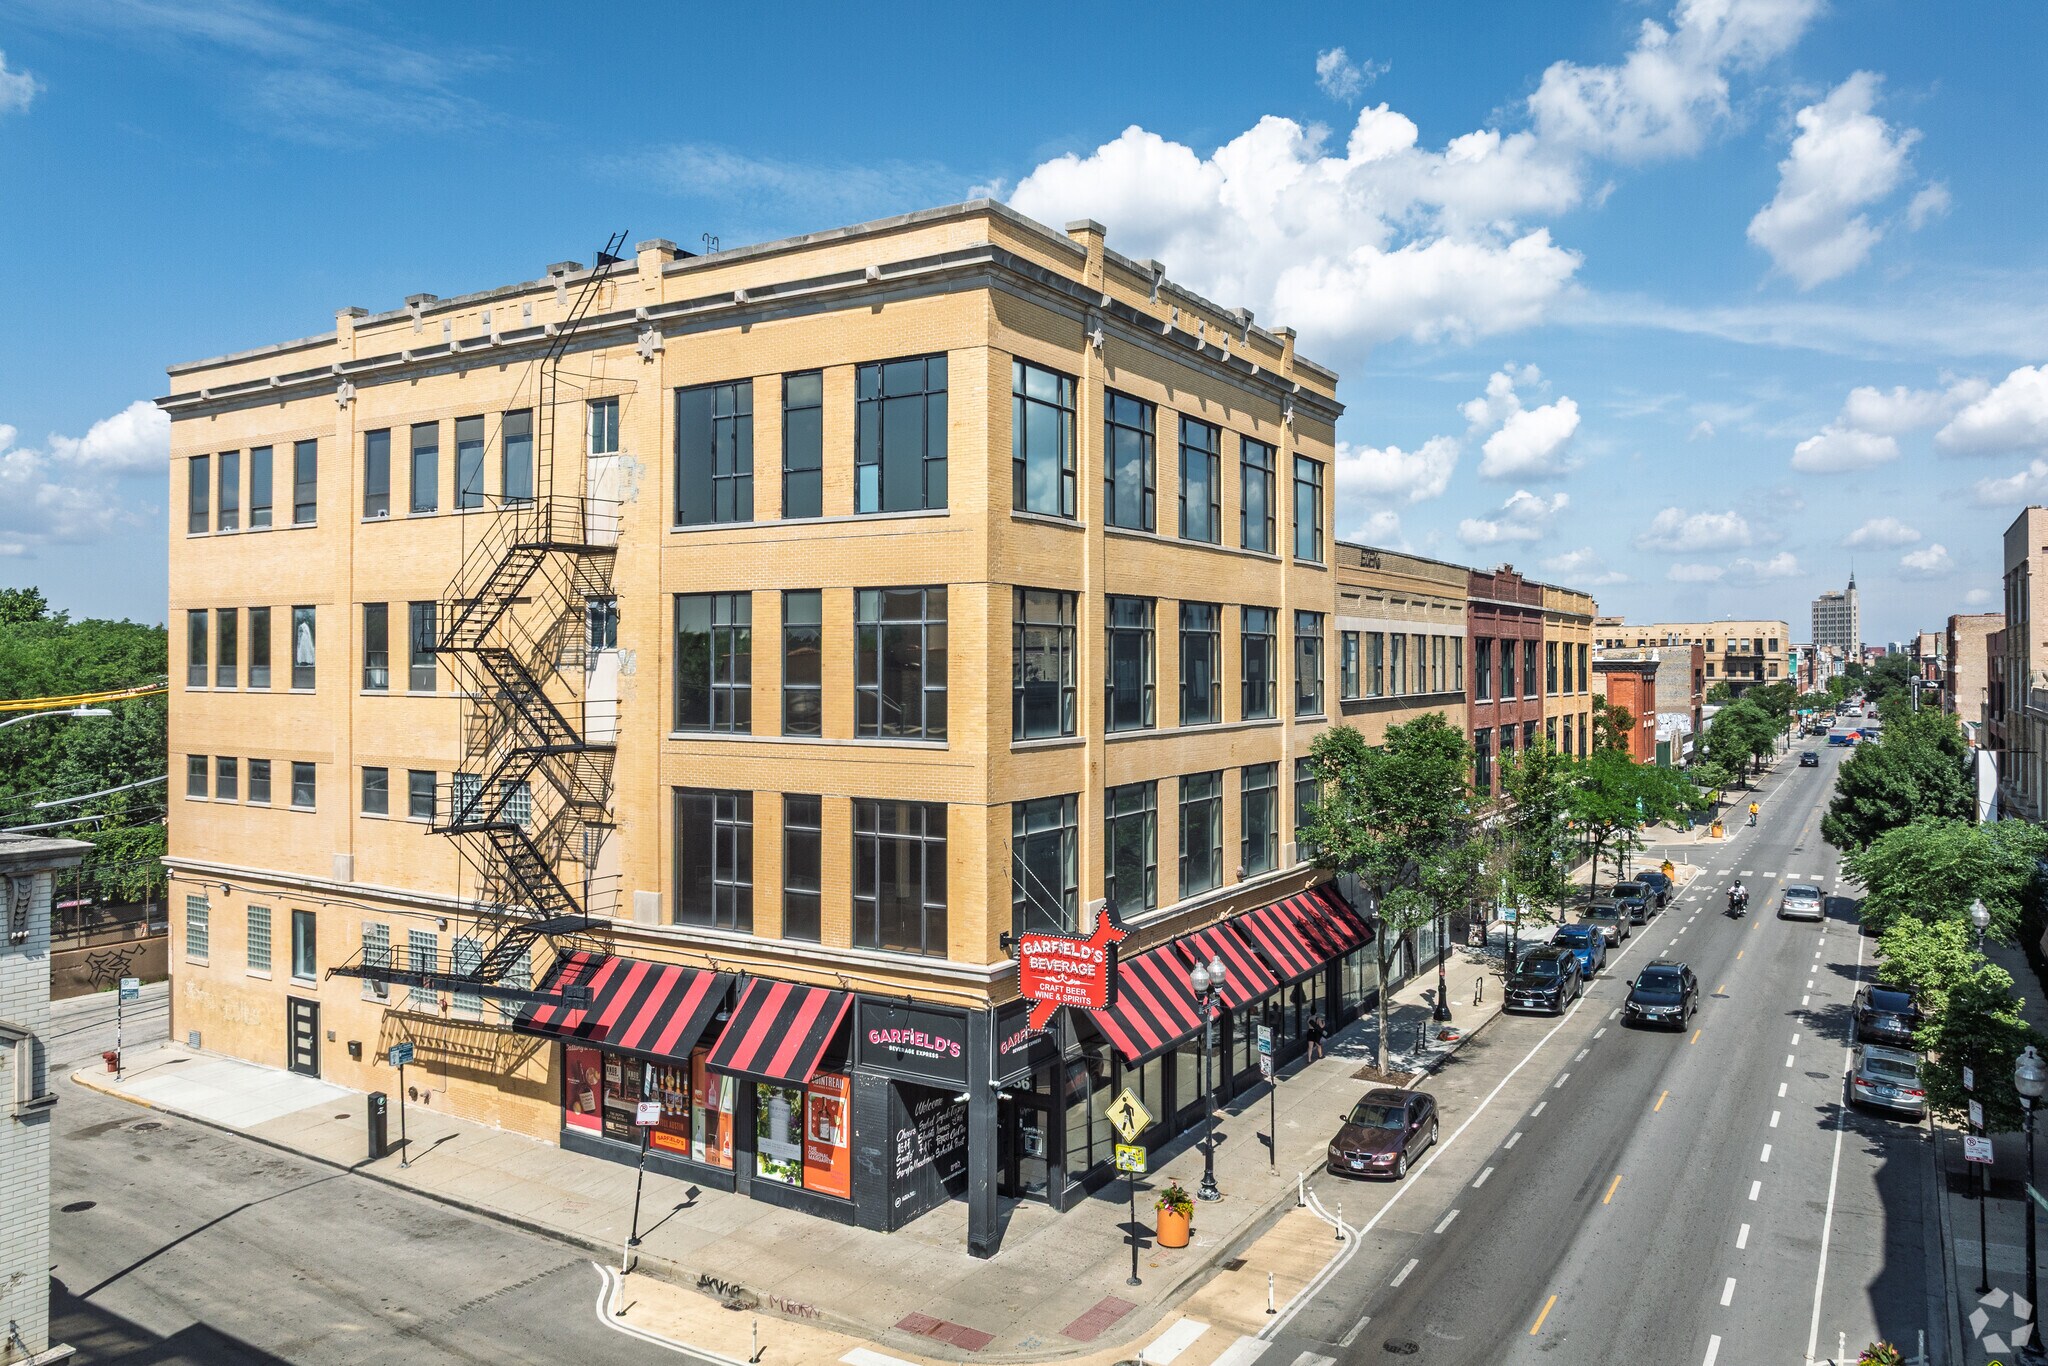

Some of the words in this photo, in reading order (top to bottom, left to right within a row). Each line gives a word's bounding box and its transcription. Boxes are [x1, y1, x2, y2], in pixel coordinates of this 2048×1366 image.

[1023, 939, 1103, 963] GARFIELD'S
[1029, 956, 1096, 977] BEVERAGE
[1034, 990, 1054, 1000] WINE
[1055, 993, 1061, 1001] &
[1062, 994, 1092, 1005] SPIRITS
[1039, 982, 1064, 992] CRAFT
[1065, 986, 1086, 996] BEER
[868, 1028, 961, 1058] GARFIELD'S
[888, 1045, 915, 1055] BEVERAGE
[915, 1049, 939, 1059] EXPRESS
